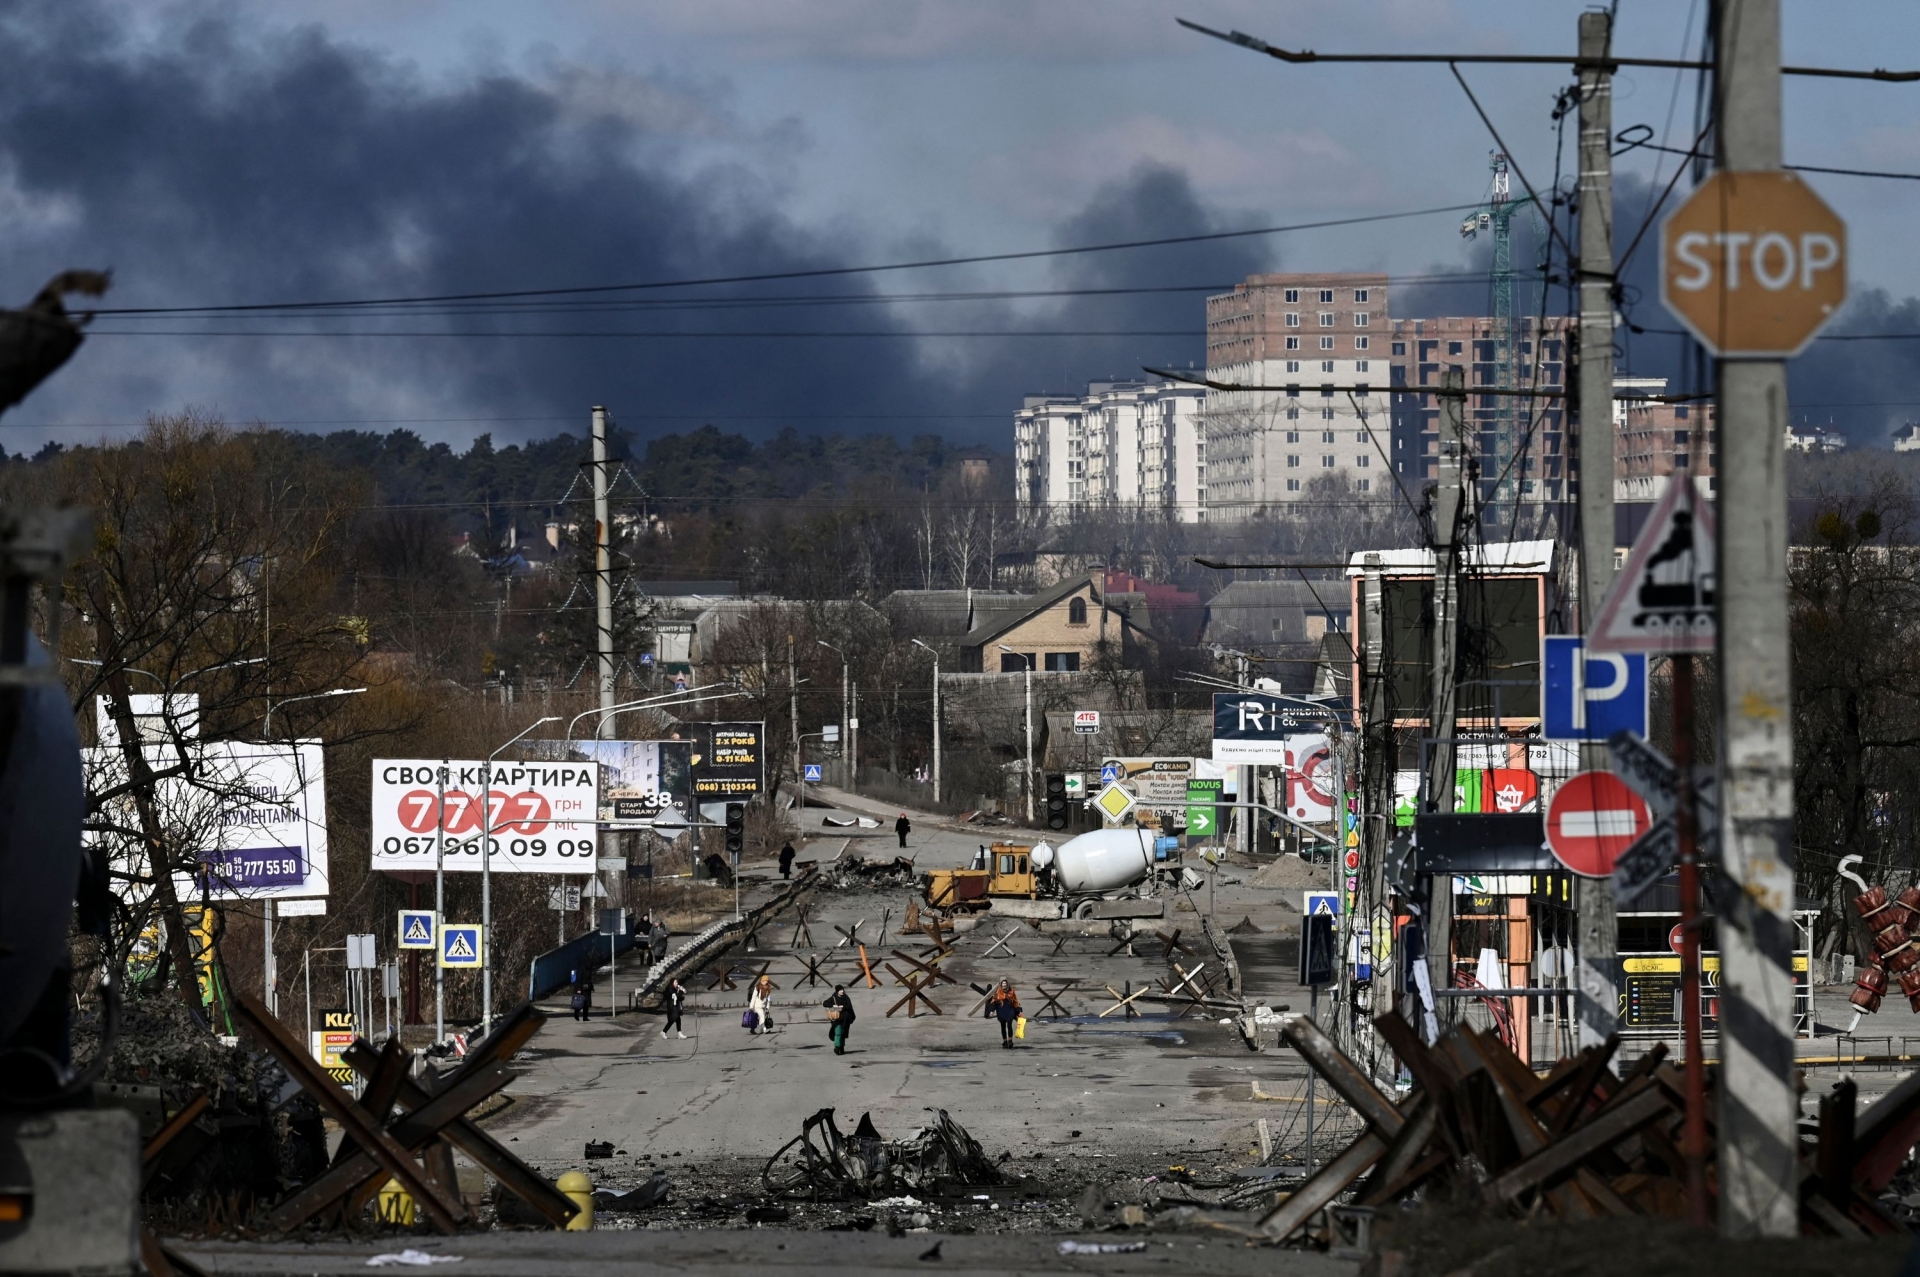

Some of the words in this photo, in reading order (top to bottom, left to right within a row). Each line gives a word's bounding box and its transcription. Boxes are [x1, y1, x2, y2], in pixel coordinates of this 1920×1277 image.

[1675, 231, 1839, 292] STOP
[1571, 645, 1630, 730] P
[1076, 713, 1096, 721] АТБ
[731, 737, 756, 745] РОКІВ
[734, 755, 755, 763] КЛАС
[1536, 751, 1548, 759] 82
[383, 766, 450, 785] СВОЯ
[460, 767, 593, 787] КВАРТИРА
[696, 783, 719, 792] (068)
[1189, 781, 1222, 789] NOVUS
[555, 799, 582, 813] грн
[554, 817, 579, 831] міс
[383, 836, 436, 855] 067
[510, 838, 547, 857] 09
[557, 839, 594, 858] 09
[234, 865, 243, 873] 73
[244, 861, 264, 876] 777
[266, 860, 280, 875] 55
[282, 859, 297, 874] 50
